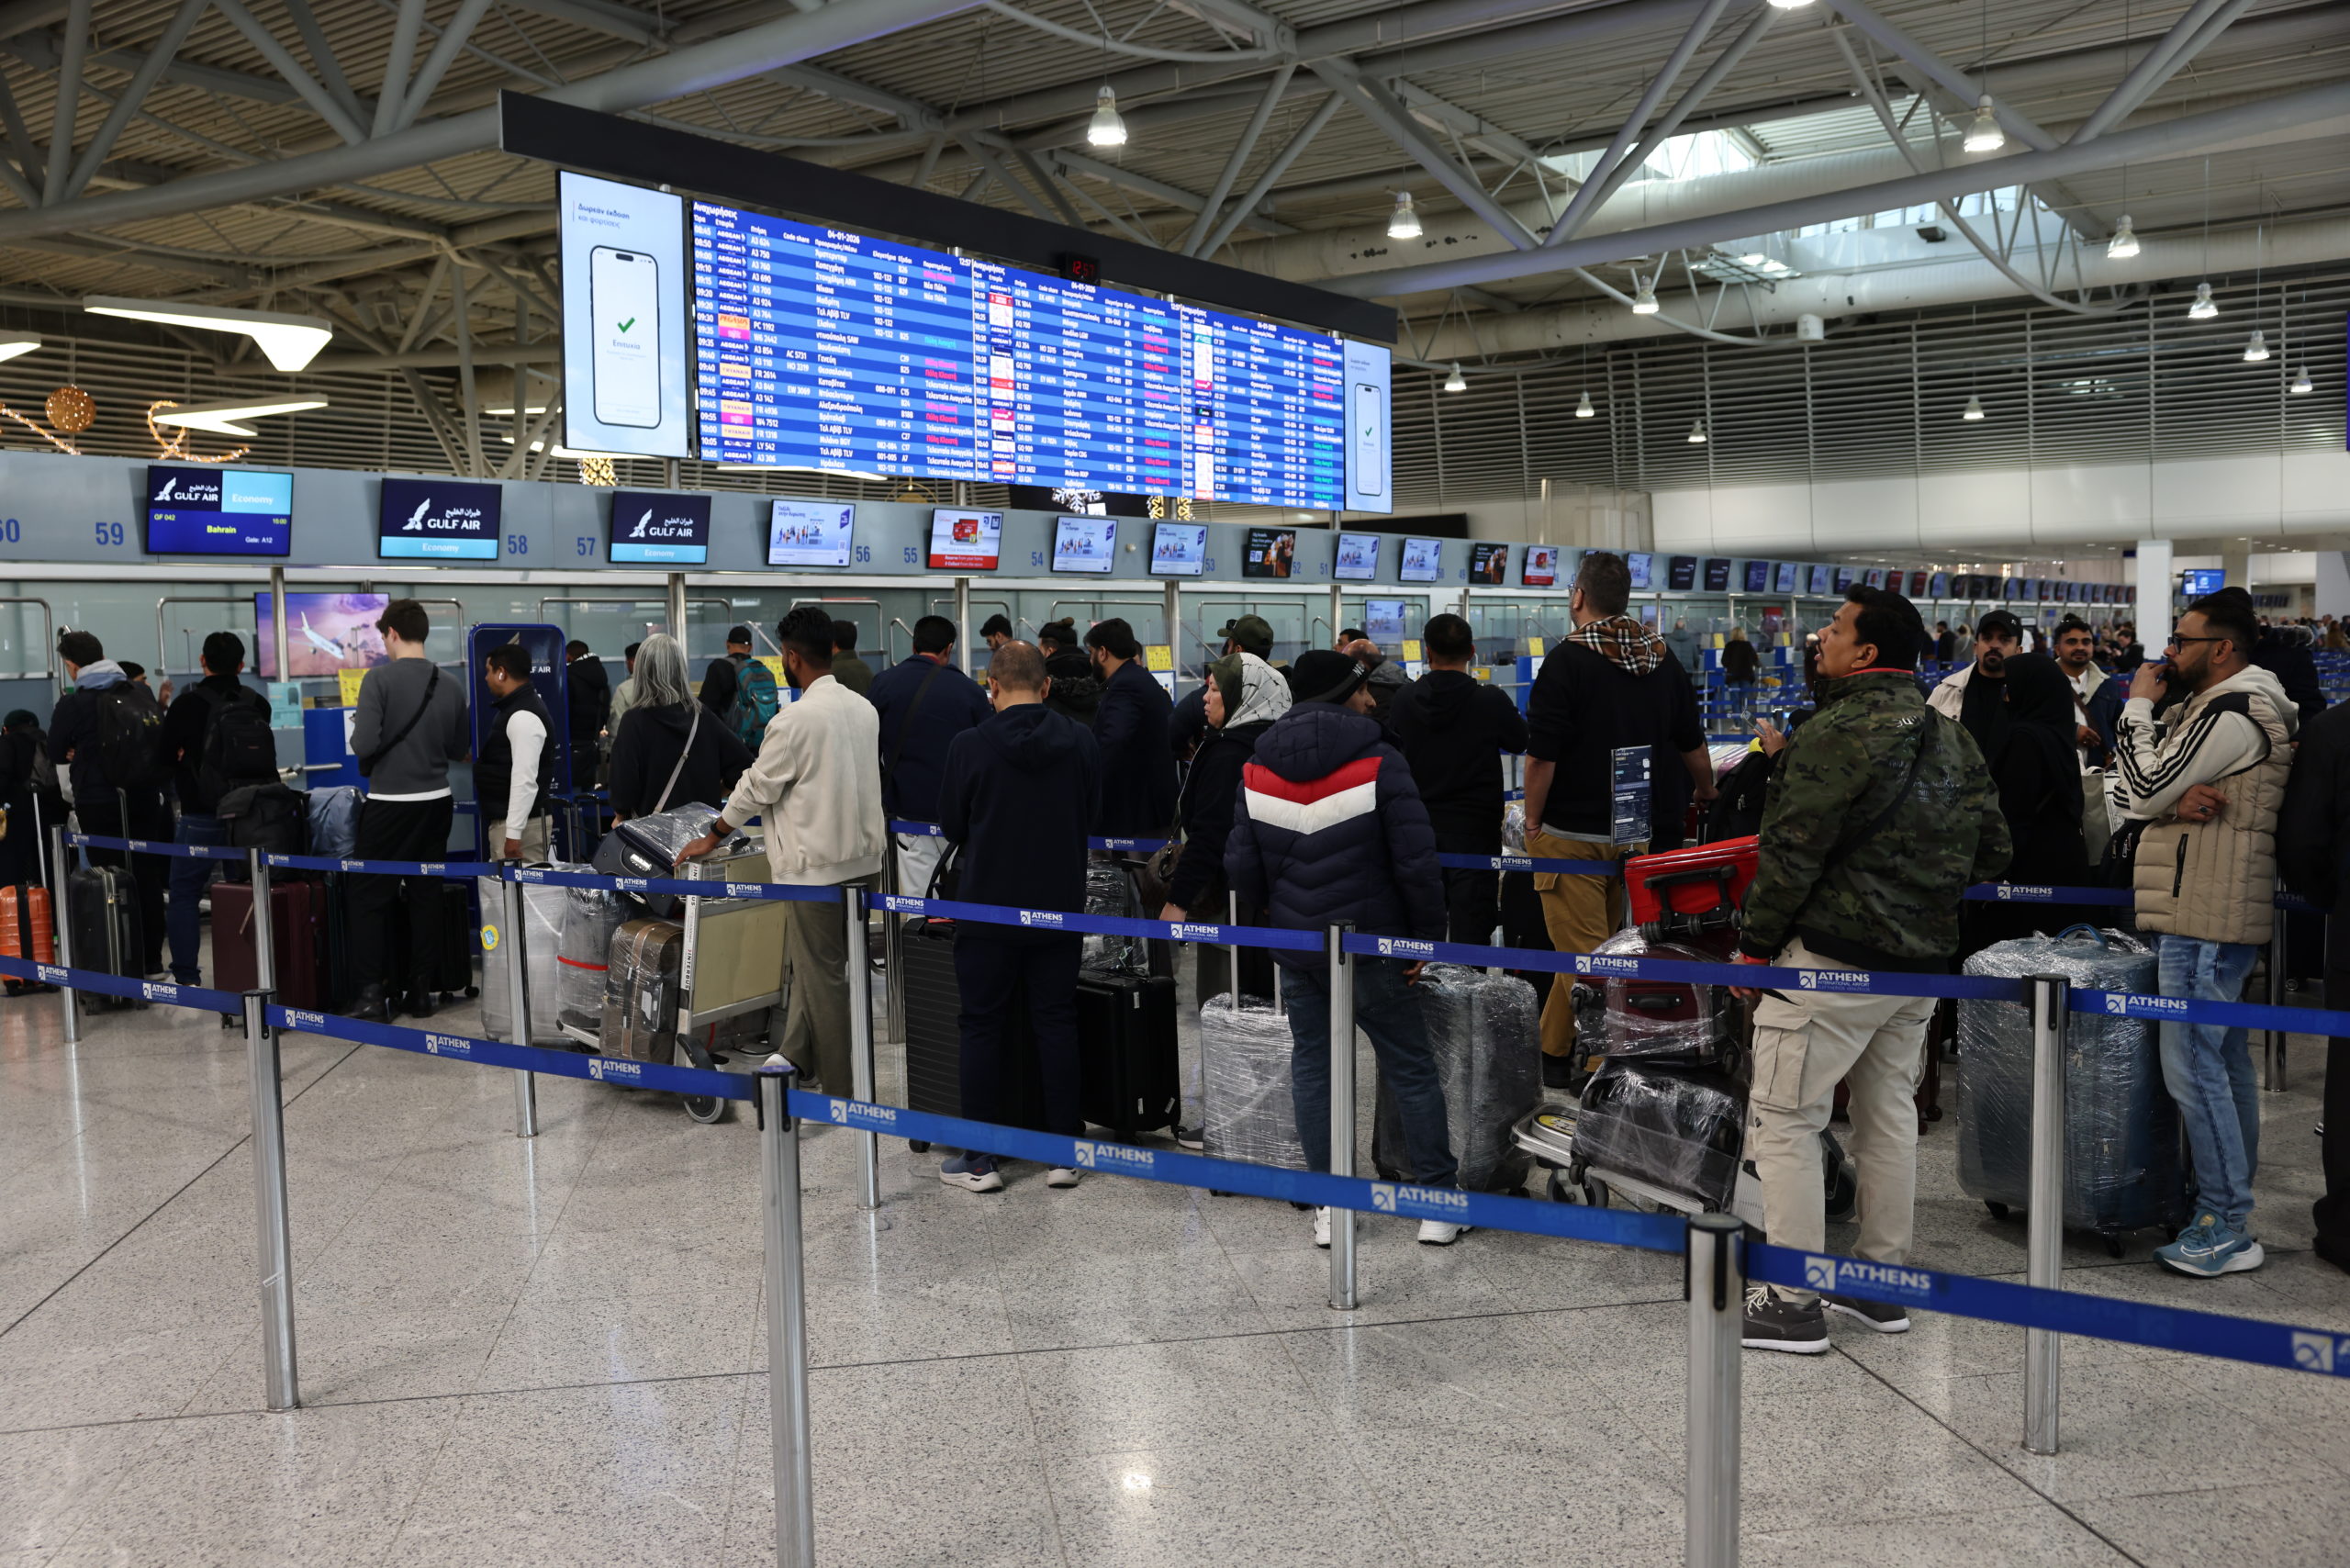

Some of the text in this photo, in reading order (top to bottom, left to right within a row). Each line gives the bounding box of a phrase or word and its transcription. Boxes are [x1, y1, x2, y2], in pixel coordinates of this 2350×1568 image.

[694, 201, 737, 220] Αναχωρήσεις
[783, 232, 795, 241] Code
[827, 230, 859, 243] 04-01-2026
[717, 242, 740, 252] AEGEAN
[751, 248, 758, 257] A3
[959, 257, 970, 266] 12:57
[753, 320, 761, 329] PC
[720, 341, 744, 349] AEGEAN
[754, 344, 761, 353] A3
[786, 349, 793, 357] AC
[755, 369, 762, 377] FR
[755, 393, 763, 401] A3
[174, 492, 218, 502] GULF AIR
[232, 494, 274, 505] Economy
[207, 525, 237, 534] Bahrain
[427, 519, 481, 530] GULF AIR
[95, 522, 124, 545] 59
[649, 527, 693, 537] GULF AIR
[422, 543, 459, 553] Economy
[508, 534, 528, 554] 58
[576, 537, 596, 556] 57
[644, 549, 675, 557] Economy
[856, 545, 870, 562] 56
[903, 547, 918, 563] 55
[1031, 551, 1044, 566] 54
[1205, 558, 1216, 572] 53
[1292, 561, 1302, 574] 52
[2012, 886, 2053, 894] ATHENS
[897, 899, 923, 907] ATHENS
[2277, 893, 2304, 903] ATHE
[1032, 912, 1063, 921] ATHENS
[1184, 924, 1219, 934] ATHENS
[1393, 939, 1434, 951] ATHENS
[1593, 957, 1639, 969] ATHENS
[46, 967, 68, 978] ATHENS
[1818, 971, 1870, 983] ATHENS
[151, 984, 177, 995] ATHENS
[2128, 996, 2188, 1010] ATHENS
[296, 1011, 324, 1024] ATHENS
[438, 1036, 470, 1049] ATHENS
[603, 1059, 641, 1074] ATHENS
[848, 1103, 896, 1120] ATHENS
[1096, 1144, 1154, 1164] ATHENS
[1397, 1187, 1468, 1207] ATHENS
[1839, 1261, 1931, 1290] ATHENS
